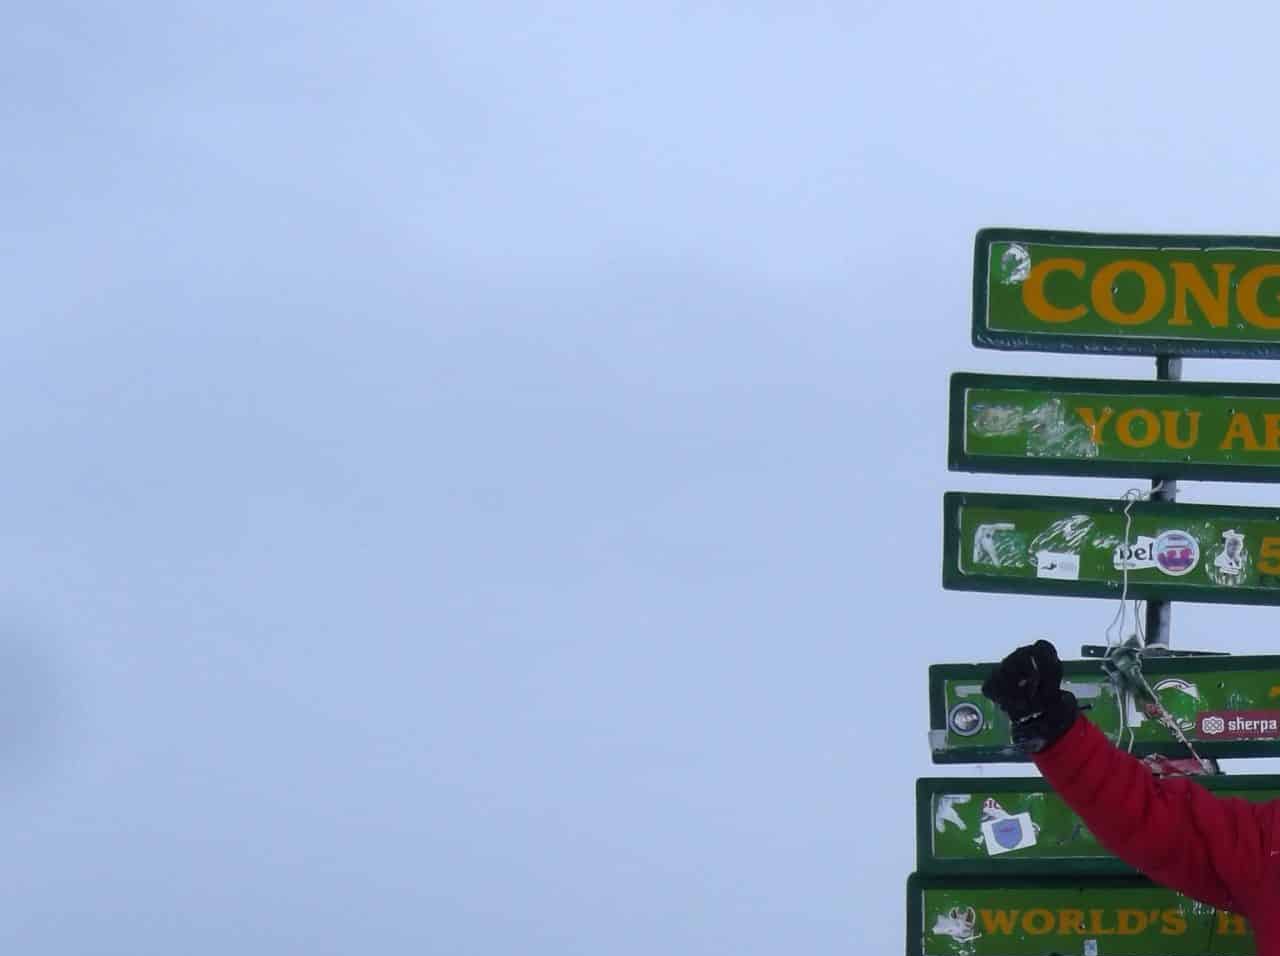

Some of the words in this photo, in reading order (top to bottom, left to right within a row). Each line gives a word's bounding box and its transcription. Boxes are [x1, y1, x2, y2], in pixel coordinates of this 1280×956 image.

[1076, 407, 1201, 450] YOU
[1228, 718, 1278, 732] sherpa
[980, 907, 1188, 936] WORLD'S
